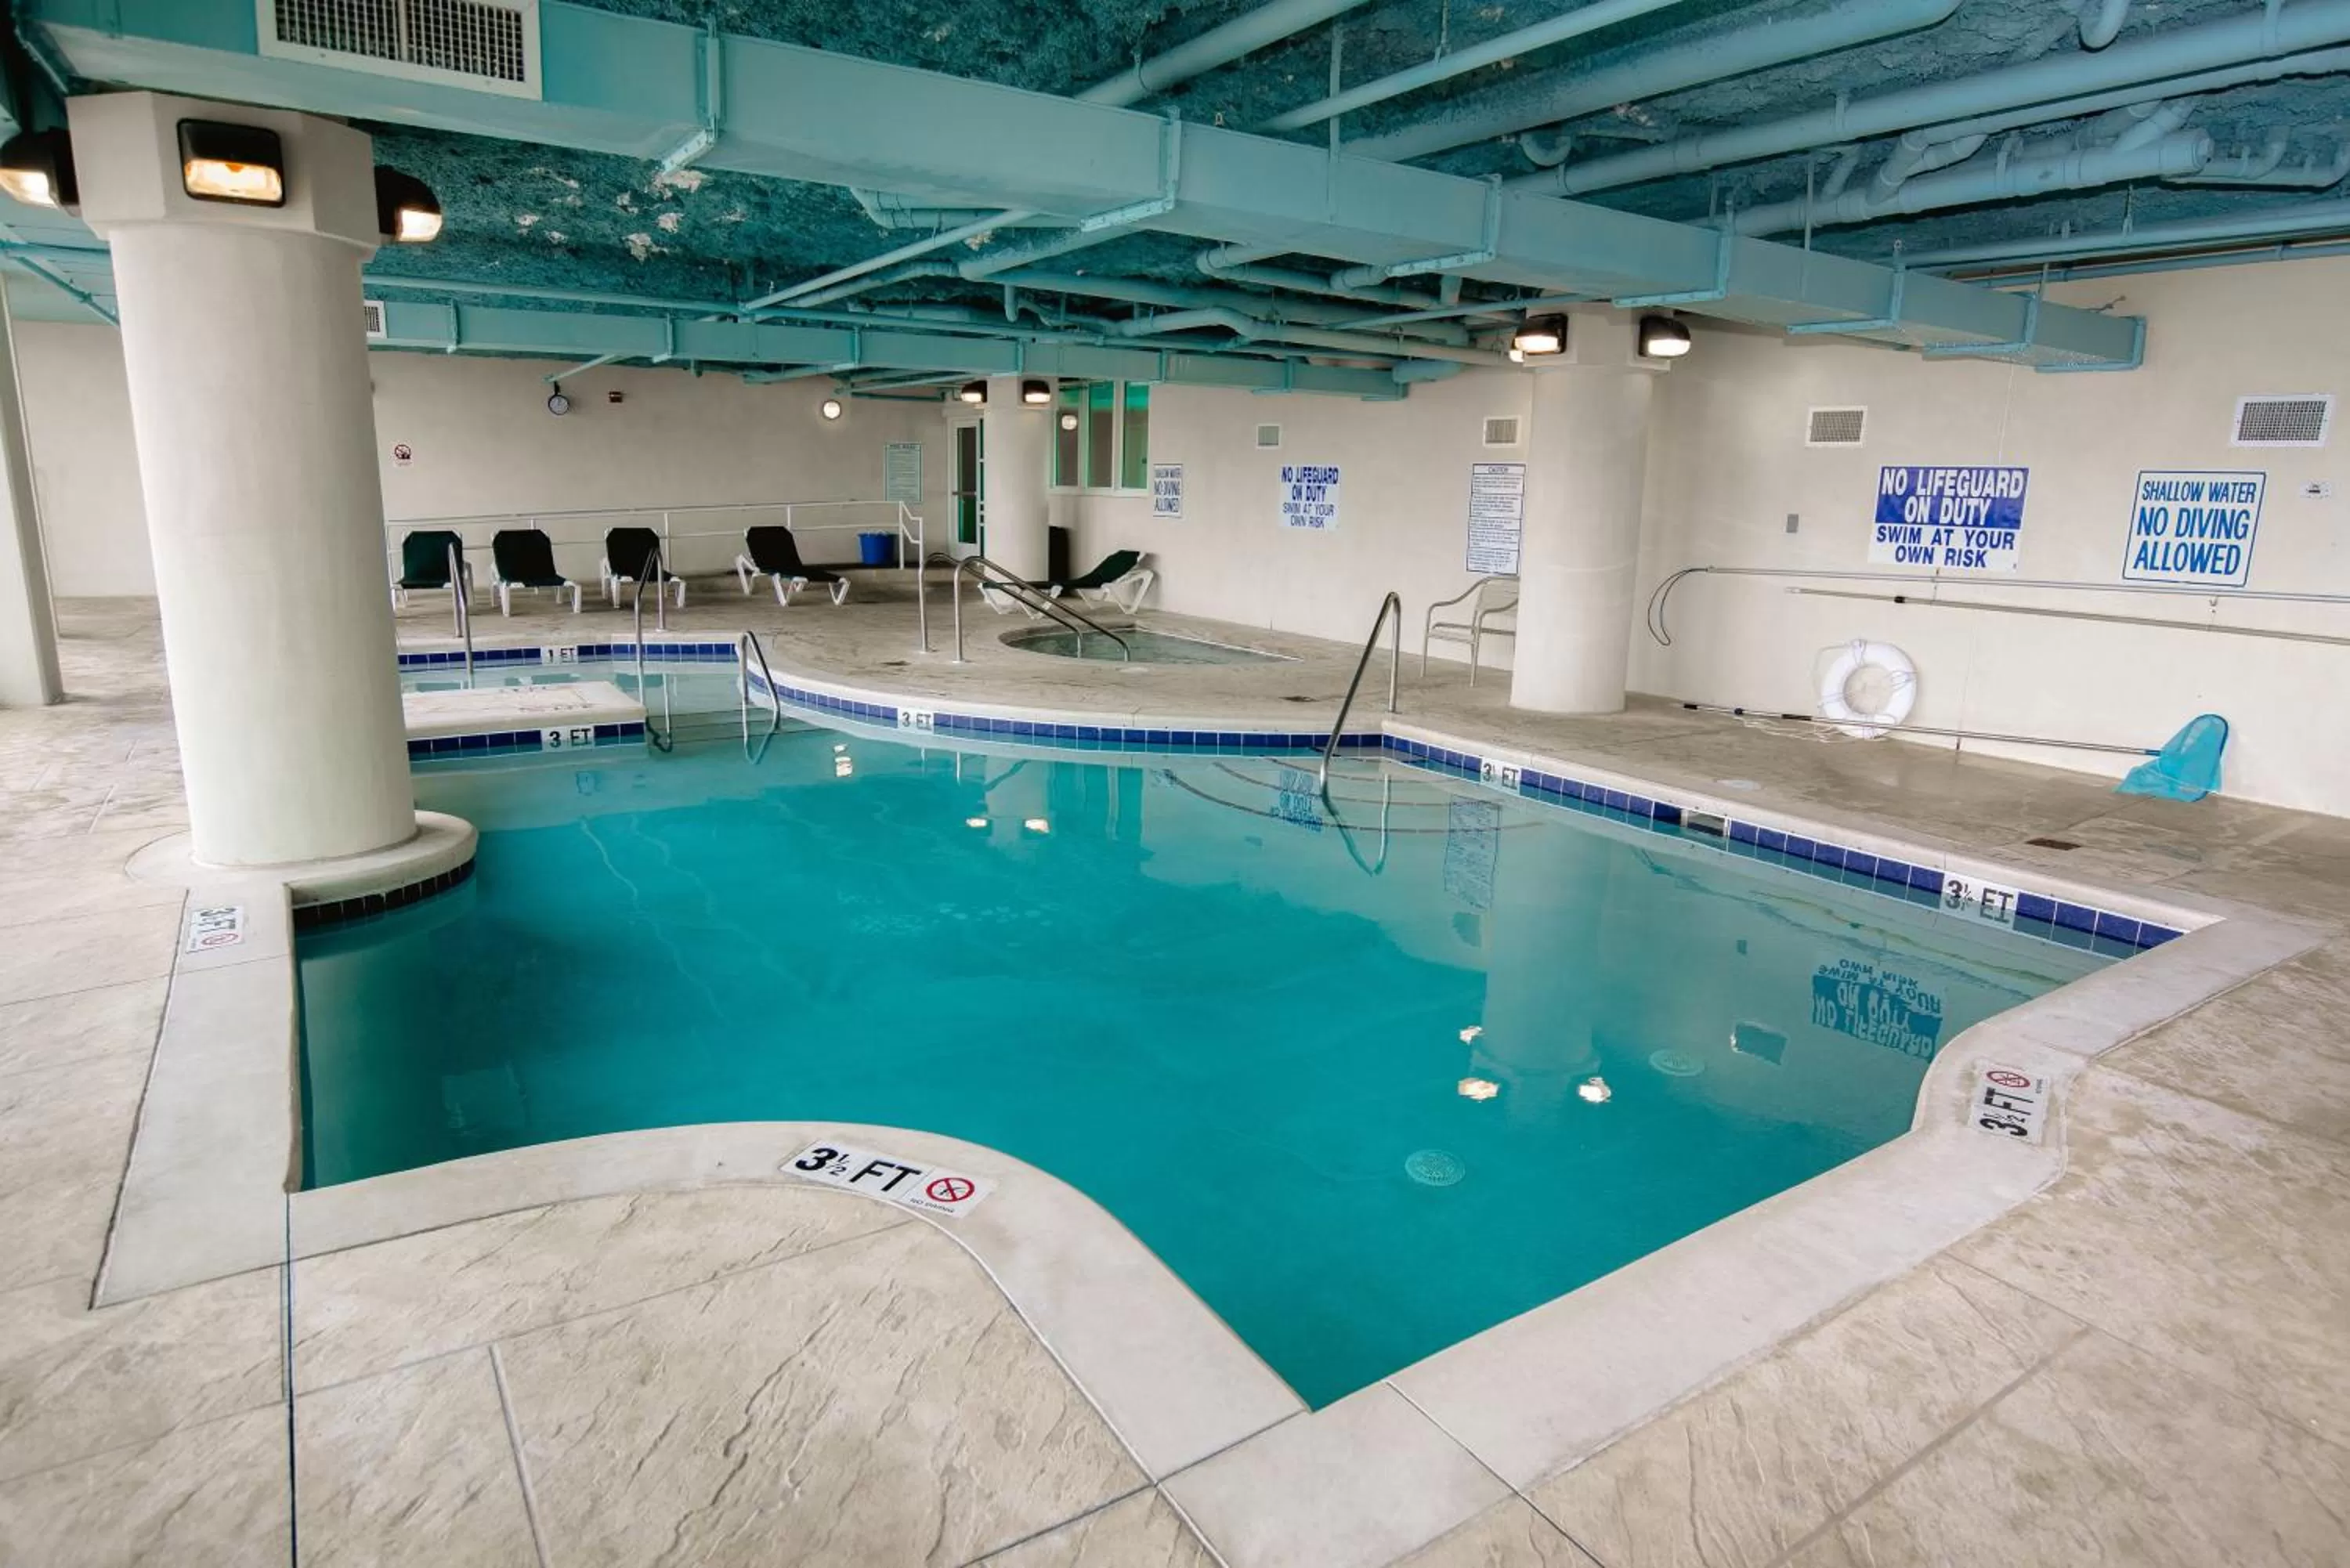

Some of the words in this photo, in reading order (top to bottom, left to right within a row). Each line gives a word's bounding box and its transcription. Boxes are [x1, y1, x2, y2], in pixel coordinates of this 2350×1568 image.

[1282, 467, 1292, 482] NO
[1296, 467, 1339, 484] LIFEGUARD
[1881, 468, 1907, 495] NO
[1916, 468, 2024, 499] LIFEGUARD
[1292, 484, 1302, 501] ON
[1306, 485, 1326, 502] DUTY
[2142, 481, 2205, 502] SHALLOW
[2209, 482, 2257, 504] WATER
[1283, 502, 1300, 514] SWIM
[1303, 503, 1312, 514] AT
[1316, 504, 1334, 517] YOUR
[1904, 496, 1931, 524] ON
[1939, 497, 1991, 526] DUTY
[1291, 515, 1306, 526] OWN
[1309, 516, 1325, 529] RISK
[2136, 506, 2169, 537] NO
[2175, 507, 2251, 540] DIVING
[1876, 525, 1922, 544] SWIM
[1930, 528, 1954, 546] AT
[1965, 529, 2016, 550] YOUR
[1895, 545, 1934, 565] OWN
[1943, 548, 1987, 568] RISK
[2133, 540, 2241, 576] ALLOWED
[902, 711, 909, 727] 3
[549, 731, 561, 746] 3
[1984, 1086, 2034, 1116] FT
[849, 1159, 922, 1193] FT
